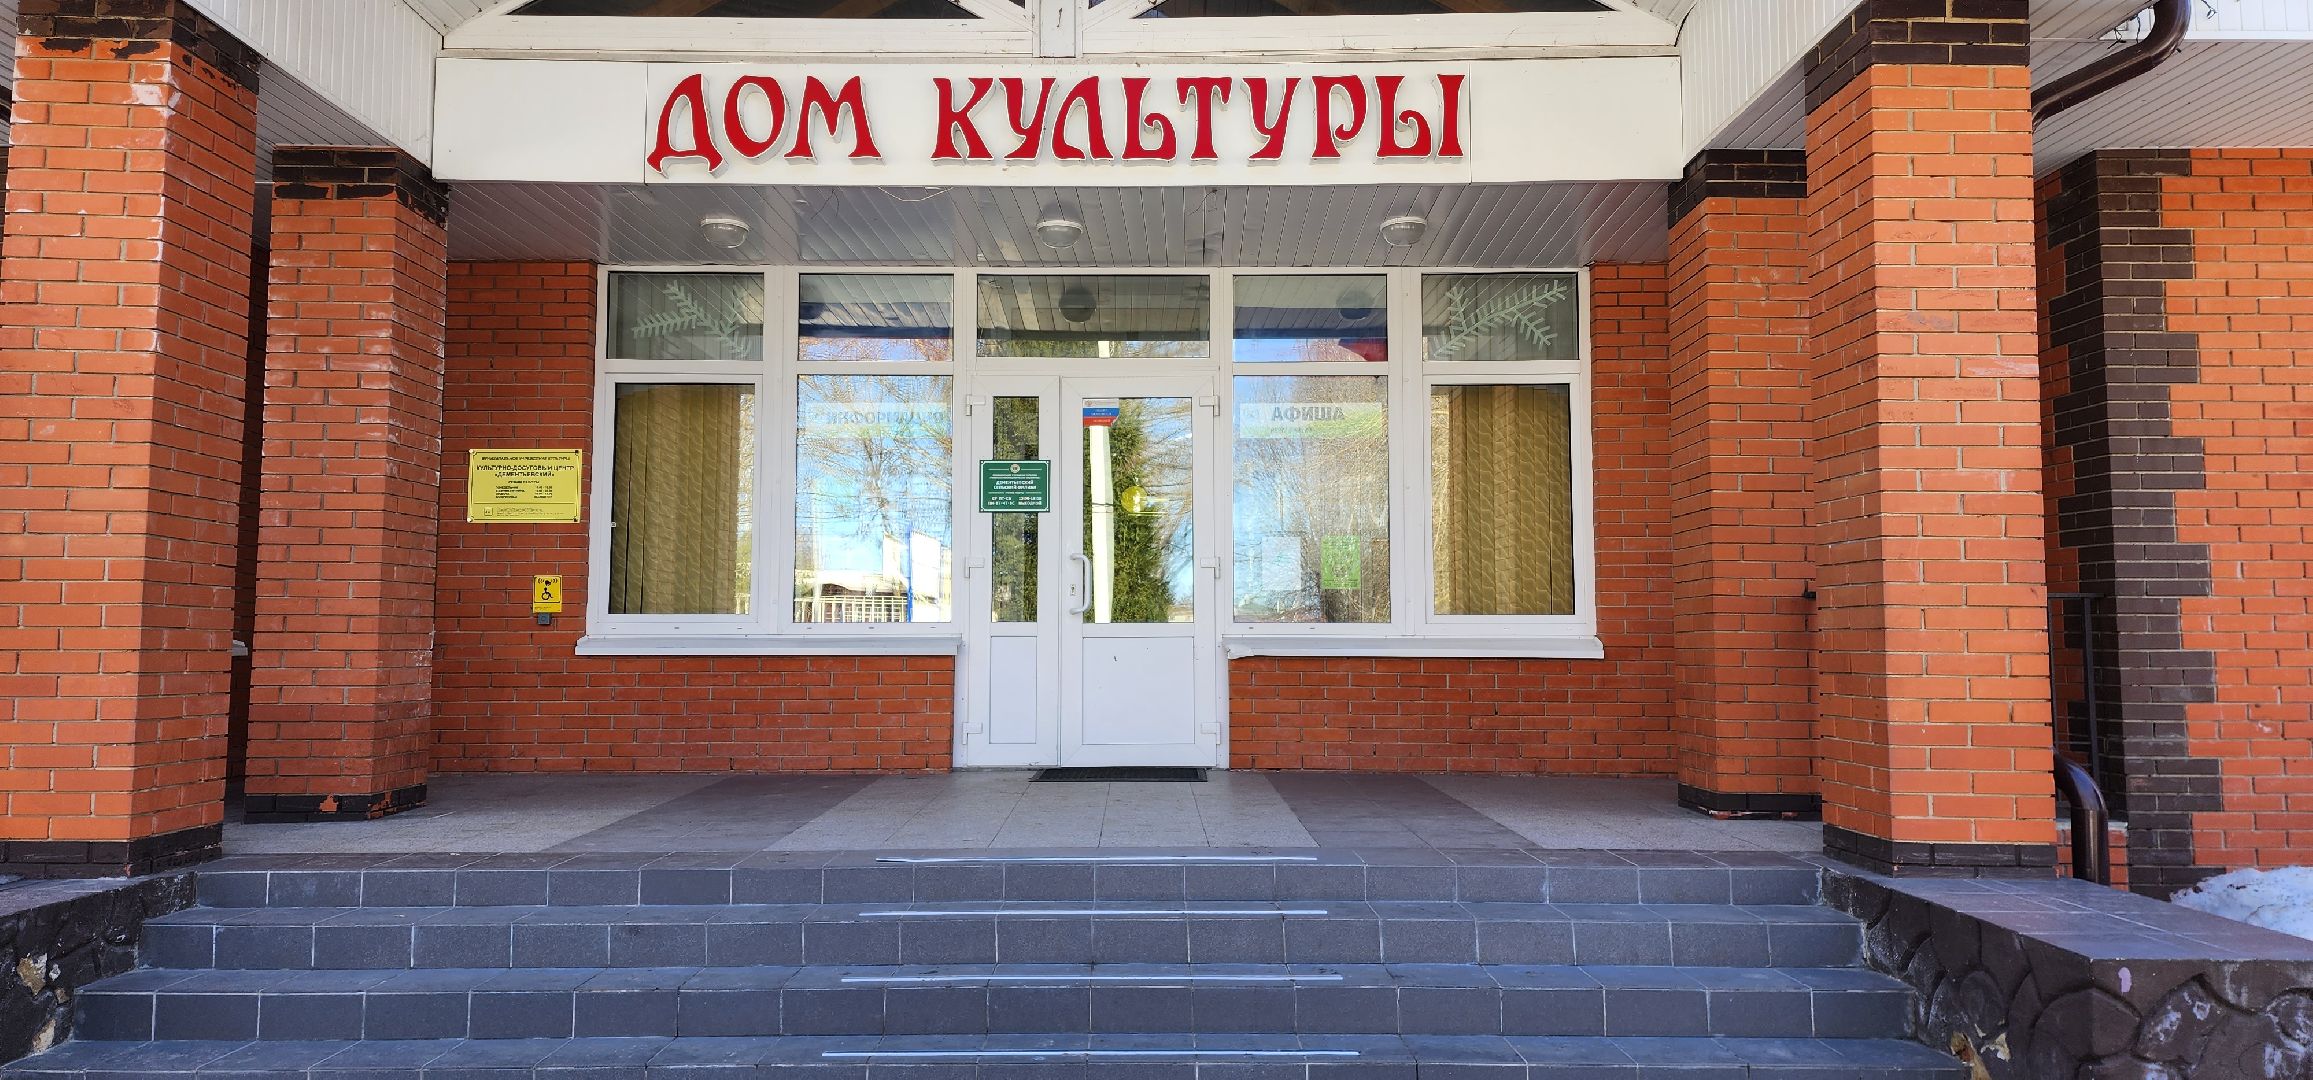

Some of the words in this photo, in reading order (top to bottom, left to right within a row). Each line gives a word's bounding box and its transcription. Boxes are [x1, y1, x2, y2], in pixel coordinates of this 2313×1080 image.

[645, 73, 885, 176] ДОМ
[930, 74, 1466, 163] КУЛЬТУРЫ
[1272, 405, 1345, 423] АФИША
